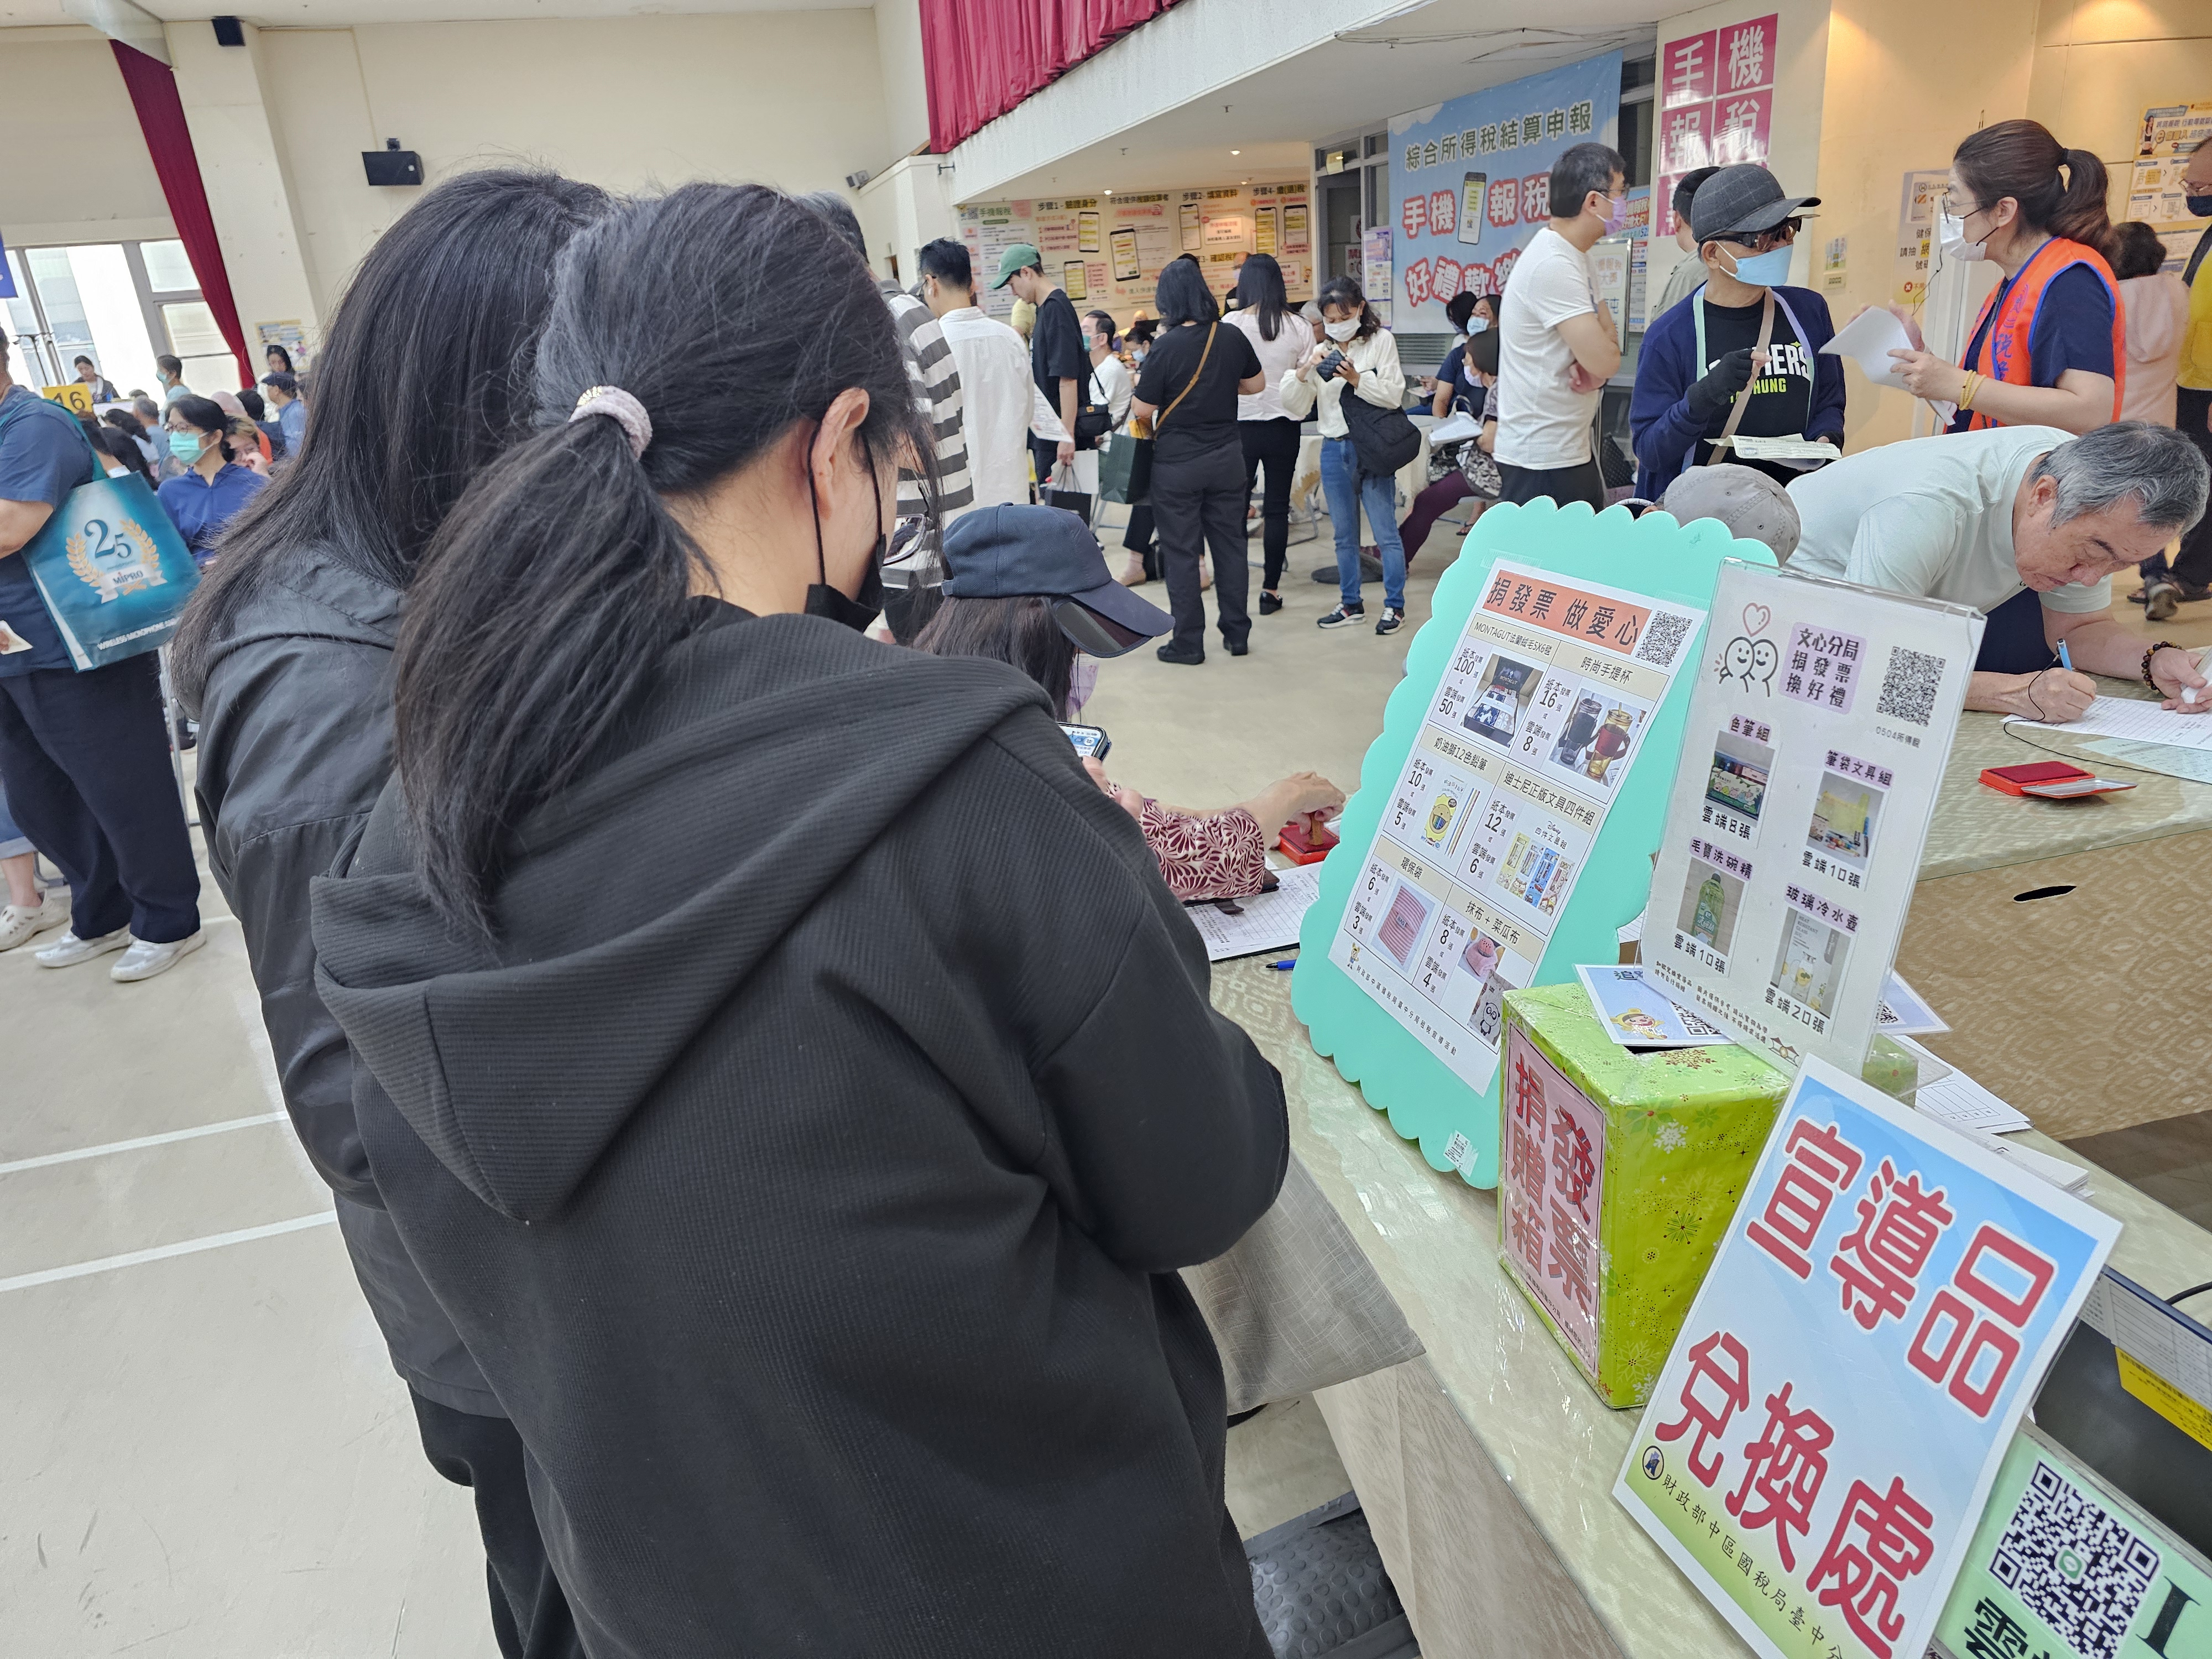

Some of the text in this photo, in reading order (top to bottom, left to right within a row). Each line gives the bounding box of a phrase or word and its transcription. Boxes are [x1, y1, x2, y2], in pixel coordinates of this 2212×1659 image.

[1671, 25, 1765, 101] 手機
[1406, 101, 1592, 171] 綜合所得稅結算申報
[1404, 176, 1550, 236] 手機 報稅
[53, 391, 86, 411] 16
[84, 519, 132, 559] 25
[1486, 577, 1640, 646] 捐發票 做愛心
[1797, 628, 1860, 661] 文心分局
[1454, 656, 1475, 675] 100
[1580, 656, 1634, 685] 時尚手提杯
[1791, 650, 1852, 684] 捐發票
[1438, 698, 1454, 715] 50
[1539, 690, 1558, 708] 16
[1785, 672, 1847, 708] 換好禮
[1523, 735, 1533, 752] 8
[1730, 716, 1771, 742] 色筆組
[1433, 736, 1488, 771] 奶油獅12色鉛筆
[1825, 749, 1893, 787] 筆袋文具組
[1408, 770, 1422, 787] 10
[1503, 770, 1595, 826] 迪士尼正版文具四件組
[1395, 811, 1404, 826] 5
[1484, 813, 1502, 833] 12
[1400, 857, 1423, 880] 環保袋
[1469, 858, 1480, 874] 6
[1691, 839, 1753, 879] 毛寶洗碗精
[1802, 850, 1861, 889] 雲端10張
[1368, 877, 1376, 890] 6
[1353, 915, 1360, 930] 3
[1465, 900, 1484, 921] 抹布
[1491, 917, 1520, 945] 菜瓜布
[1786, 885, 1859, 932] 玻璃冷水壺
[1440, 929, 1449, 945] 8
[1674, 933, 1726, 974] 雲端10張
[1423, 973, 1433, 988] 4
[1765, 987, 1826, 1035] 雲端20張
[1511, 1052, 1548, 1278] 捐贈箱
[1548, 1104, 1595, 1324] 發票
[1745, 1117, 2057, 1420] 宣導品
[1653, 1329, 1936, 1659] 兌換處
